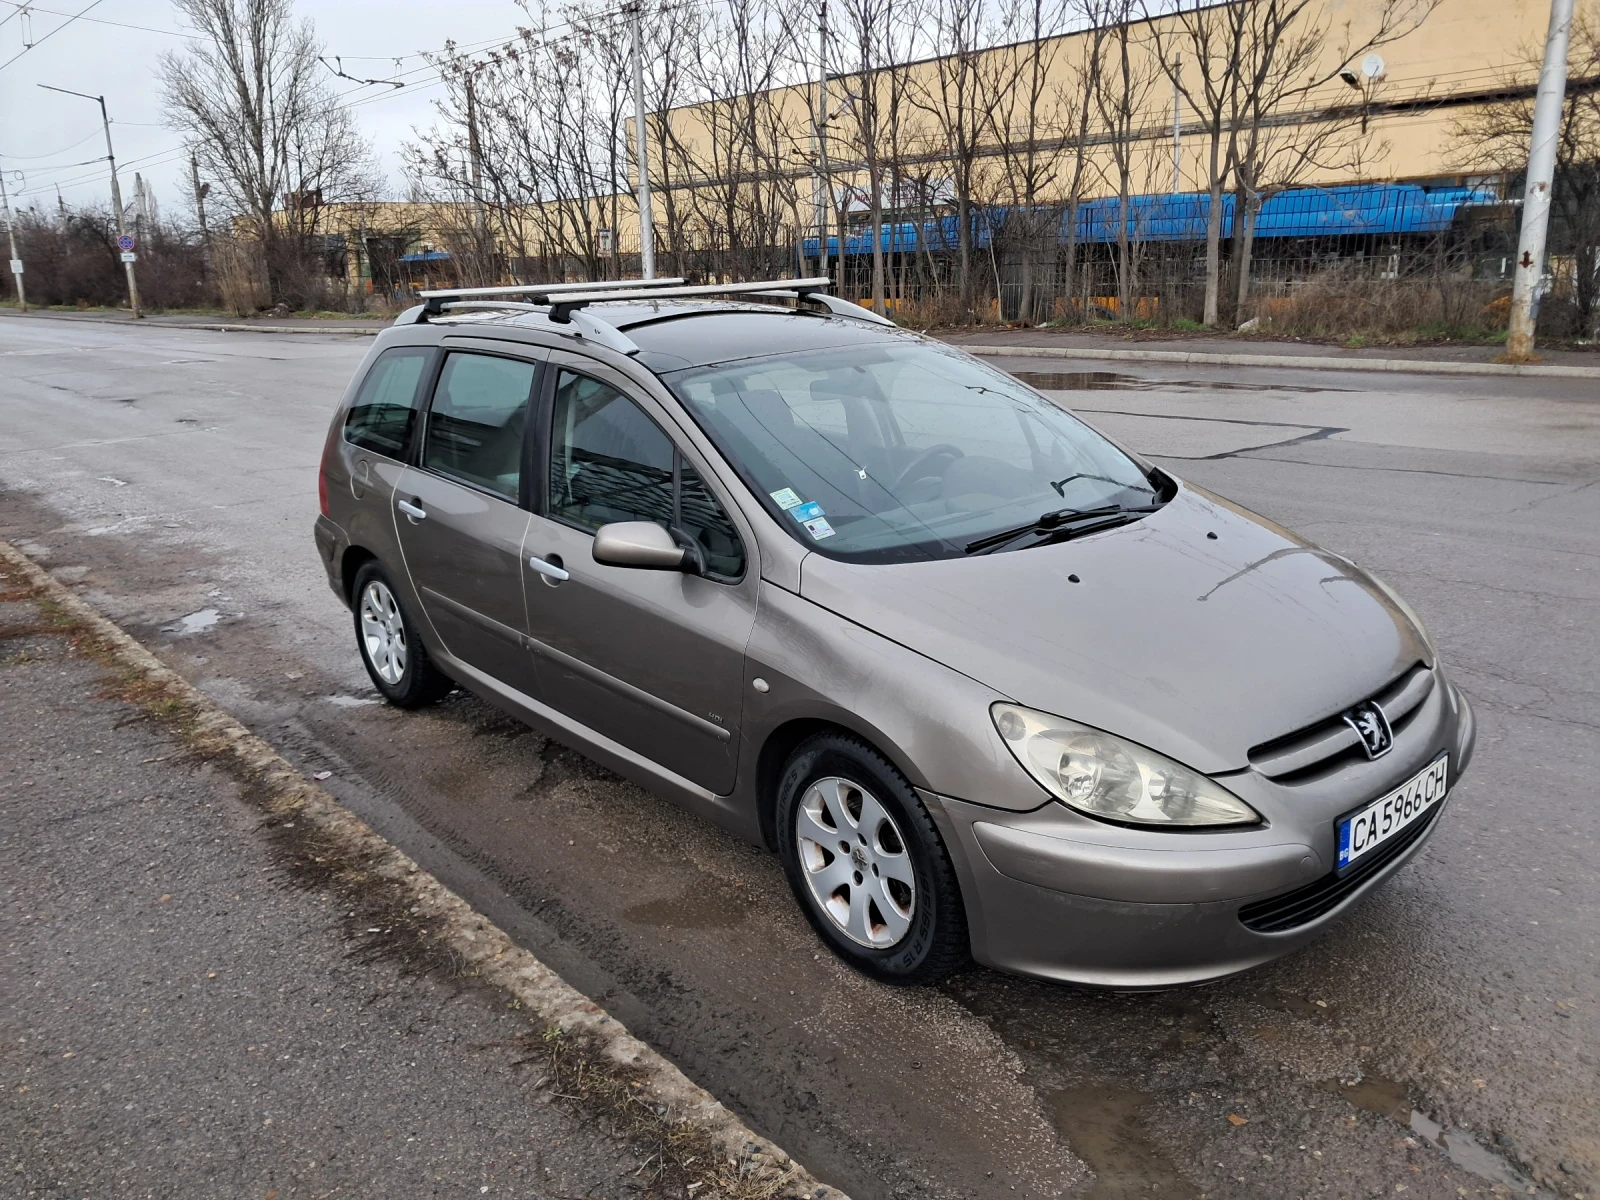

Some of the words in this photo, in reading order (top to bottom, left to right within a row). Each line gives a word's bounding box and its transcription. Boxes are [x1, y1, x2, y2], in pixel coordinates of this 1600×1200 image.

[1354, 811, 1377, 852] CA
[1382, 780, 1421, 834] 5966
[1425, 762, 1445, 803] CH
[1339, 848, 1349, 861] BG
